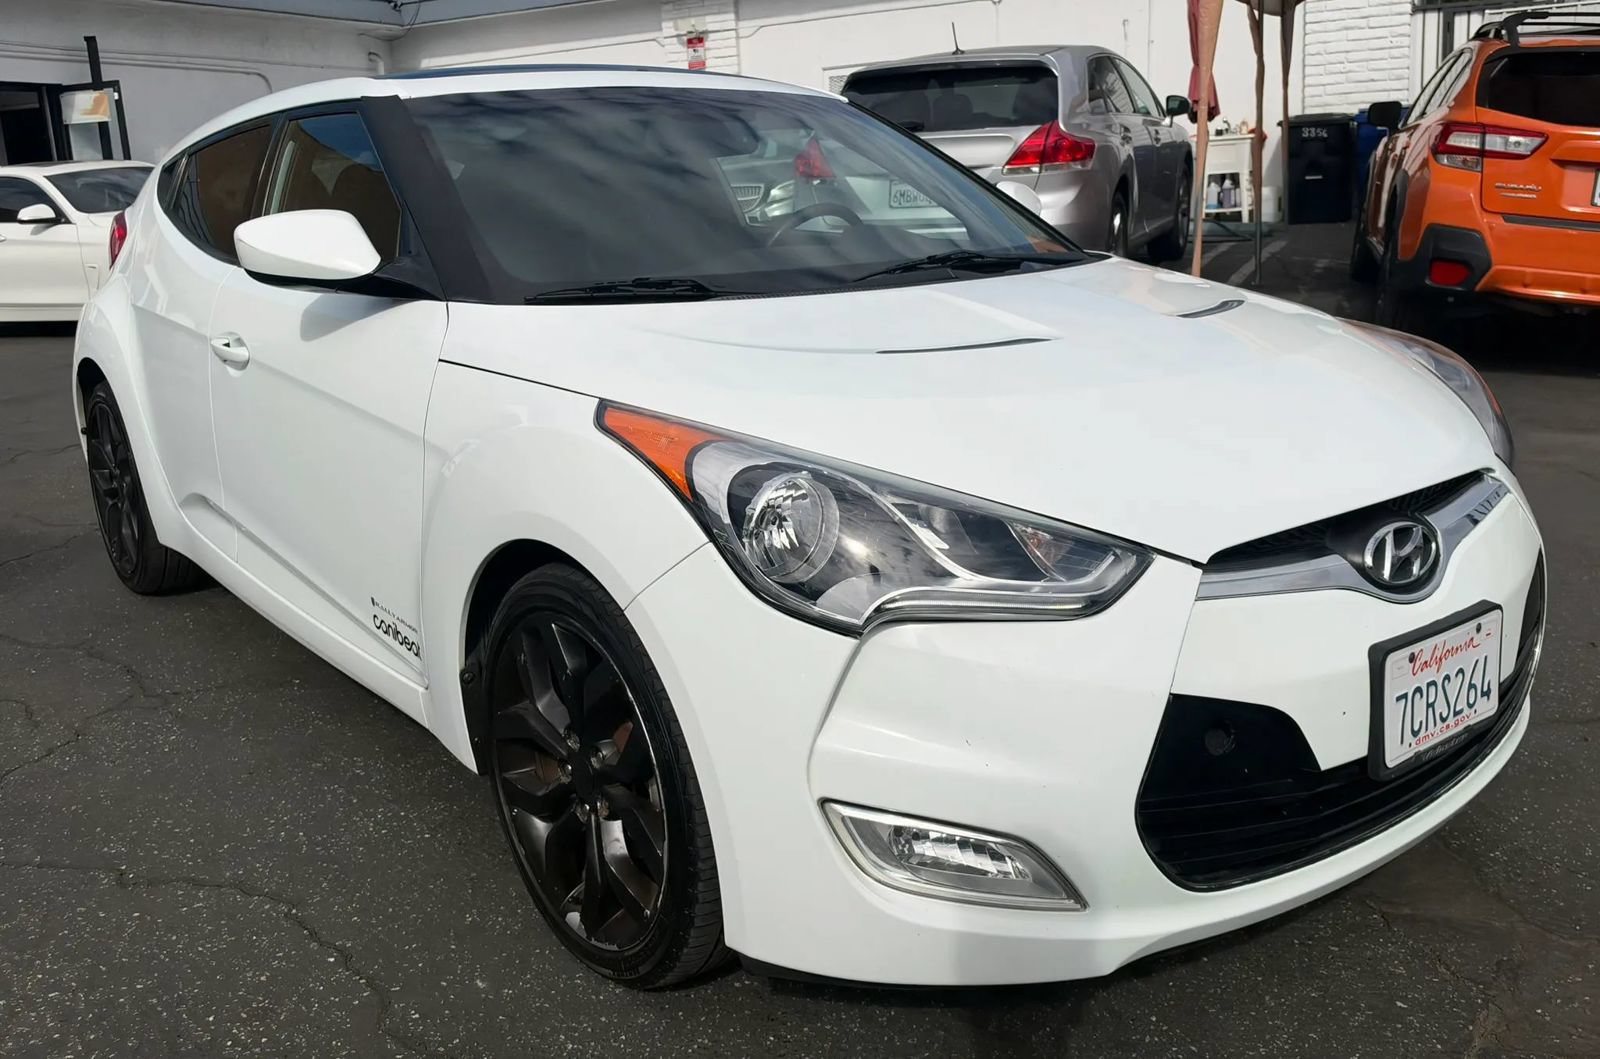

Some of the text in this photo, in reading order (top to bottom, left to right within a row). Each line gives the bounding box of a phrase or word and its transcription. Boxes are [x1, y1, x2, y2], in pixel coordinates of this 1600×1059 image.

[1411, 636, 1480, 676] California
[1395, 655, 1492, 746] 7CRS264
[1415, 712, 1472, 746] dmv.ca.gov
